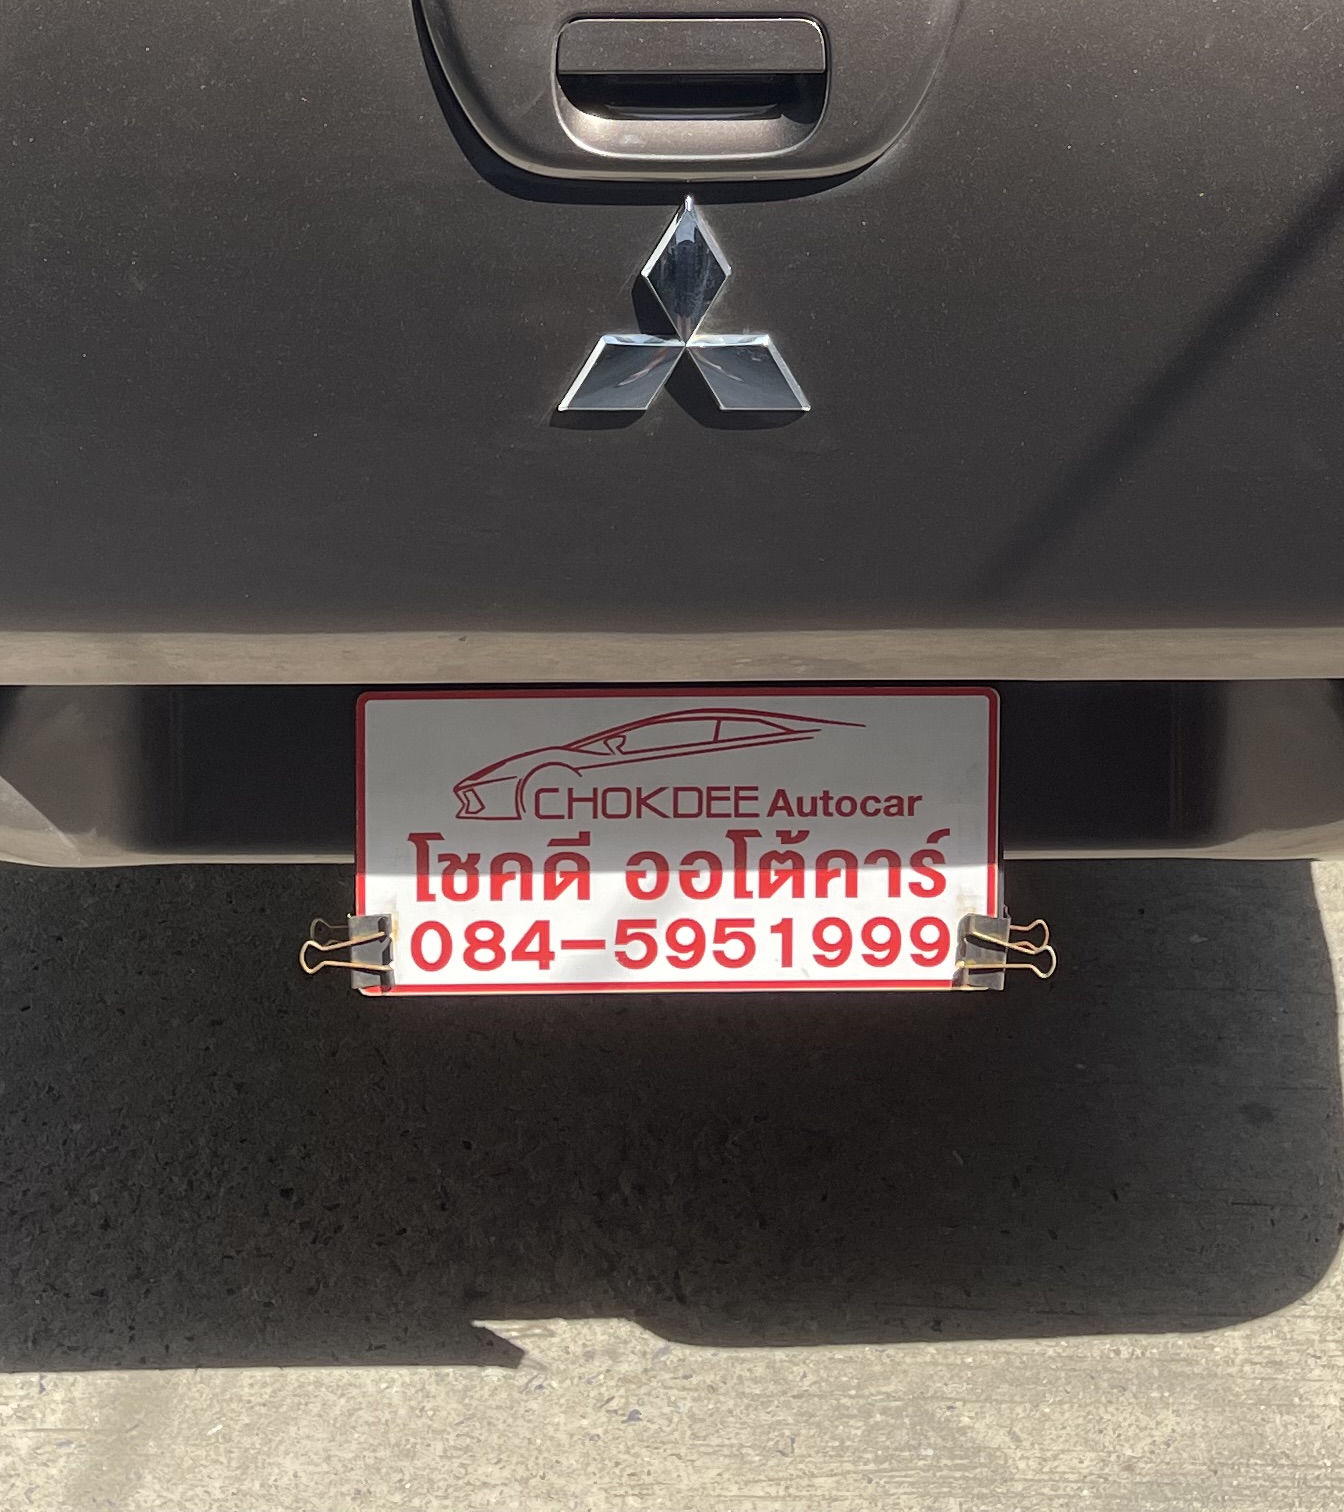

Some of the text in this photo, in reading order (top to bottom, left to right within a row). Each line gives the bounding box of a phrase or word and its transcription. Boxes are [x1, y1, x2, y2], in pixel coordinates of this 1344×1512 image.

[532, 785, 923, 820] CHOKDEE Autocar
[407, 828, 952, 903] โชคดี ออโต้คาร์
[408, 915, 952, 974] 084-5951999
